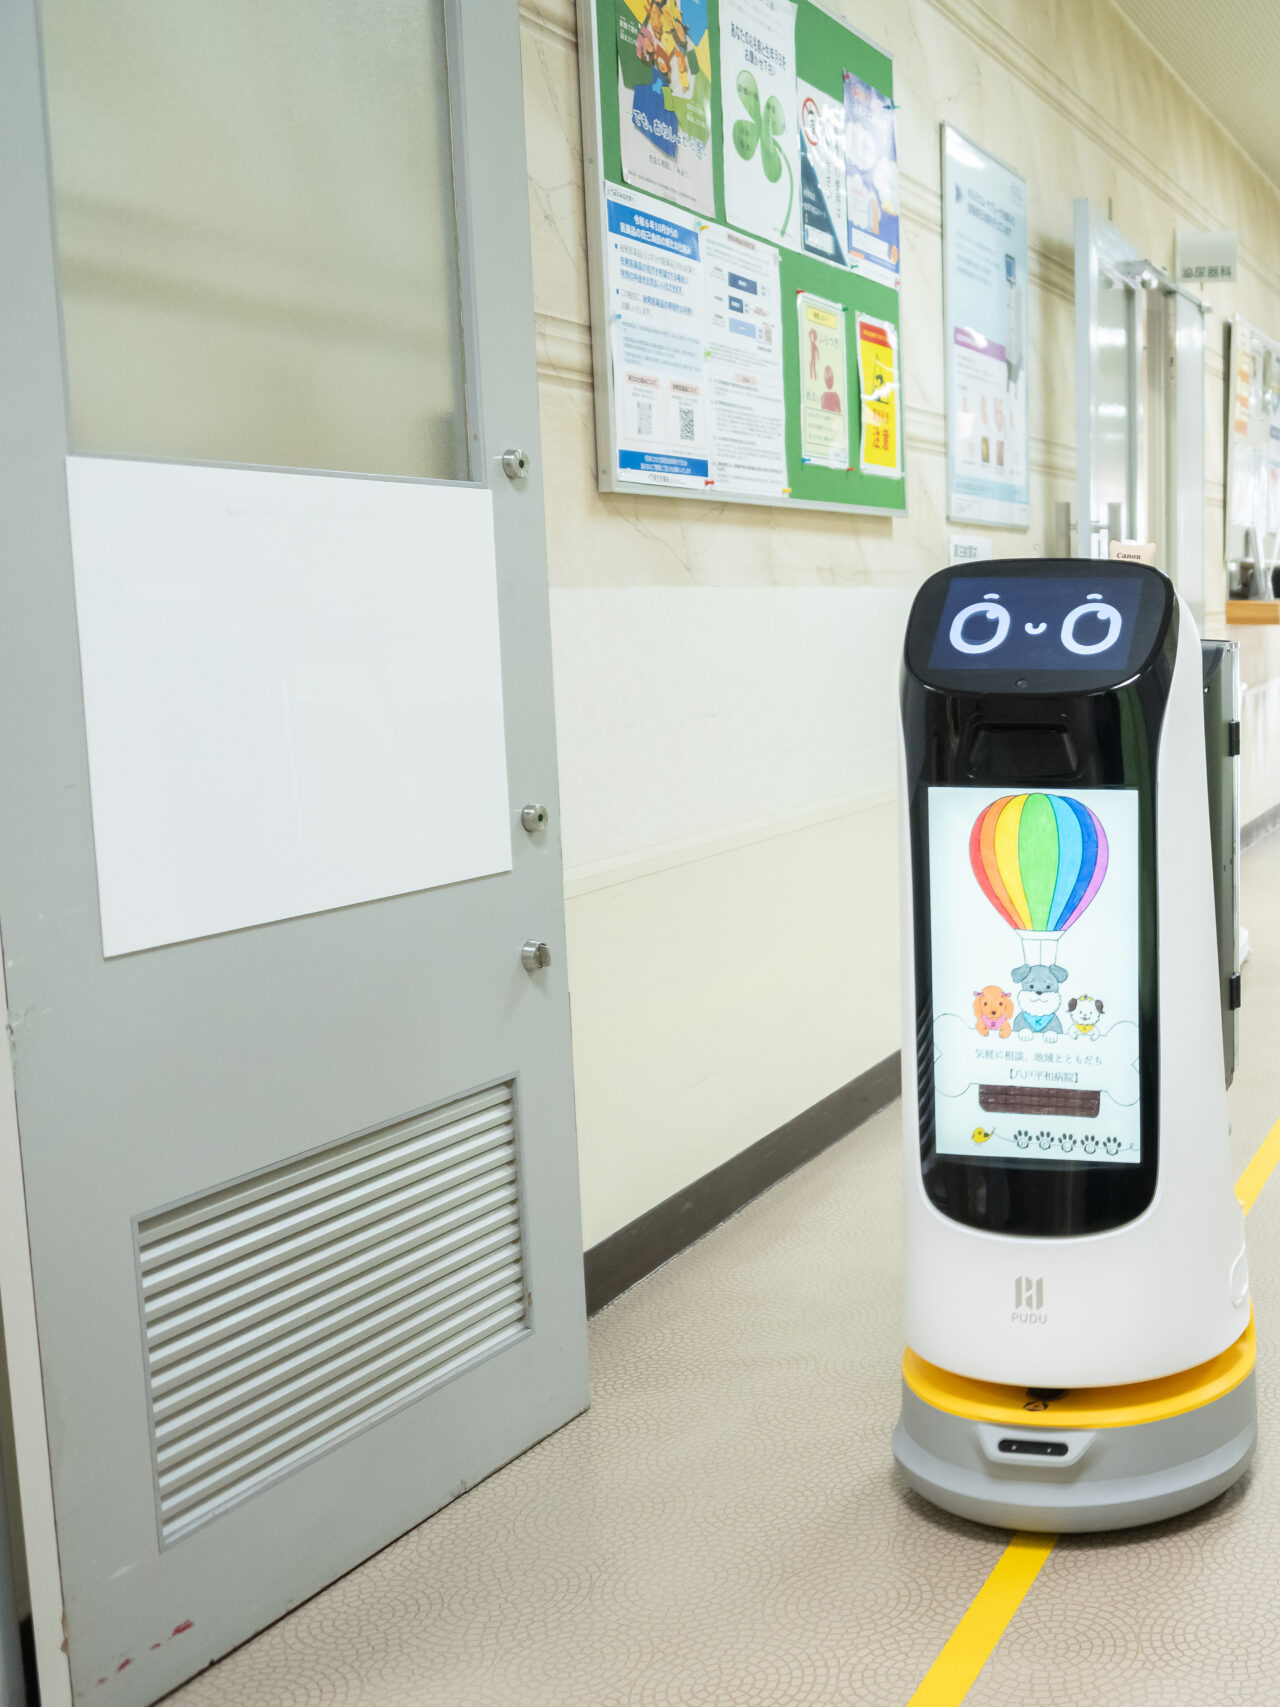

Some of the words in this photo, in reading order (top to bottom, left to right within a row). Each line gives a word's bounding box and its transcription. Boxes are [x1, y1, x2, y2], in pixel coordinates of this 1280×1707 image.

[1116, 552, 1141, 560] Canon
[1035, 1018, 1042, 1026] K
[1011, 1312, 1048, 1324] PUDU
